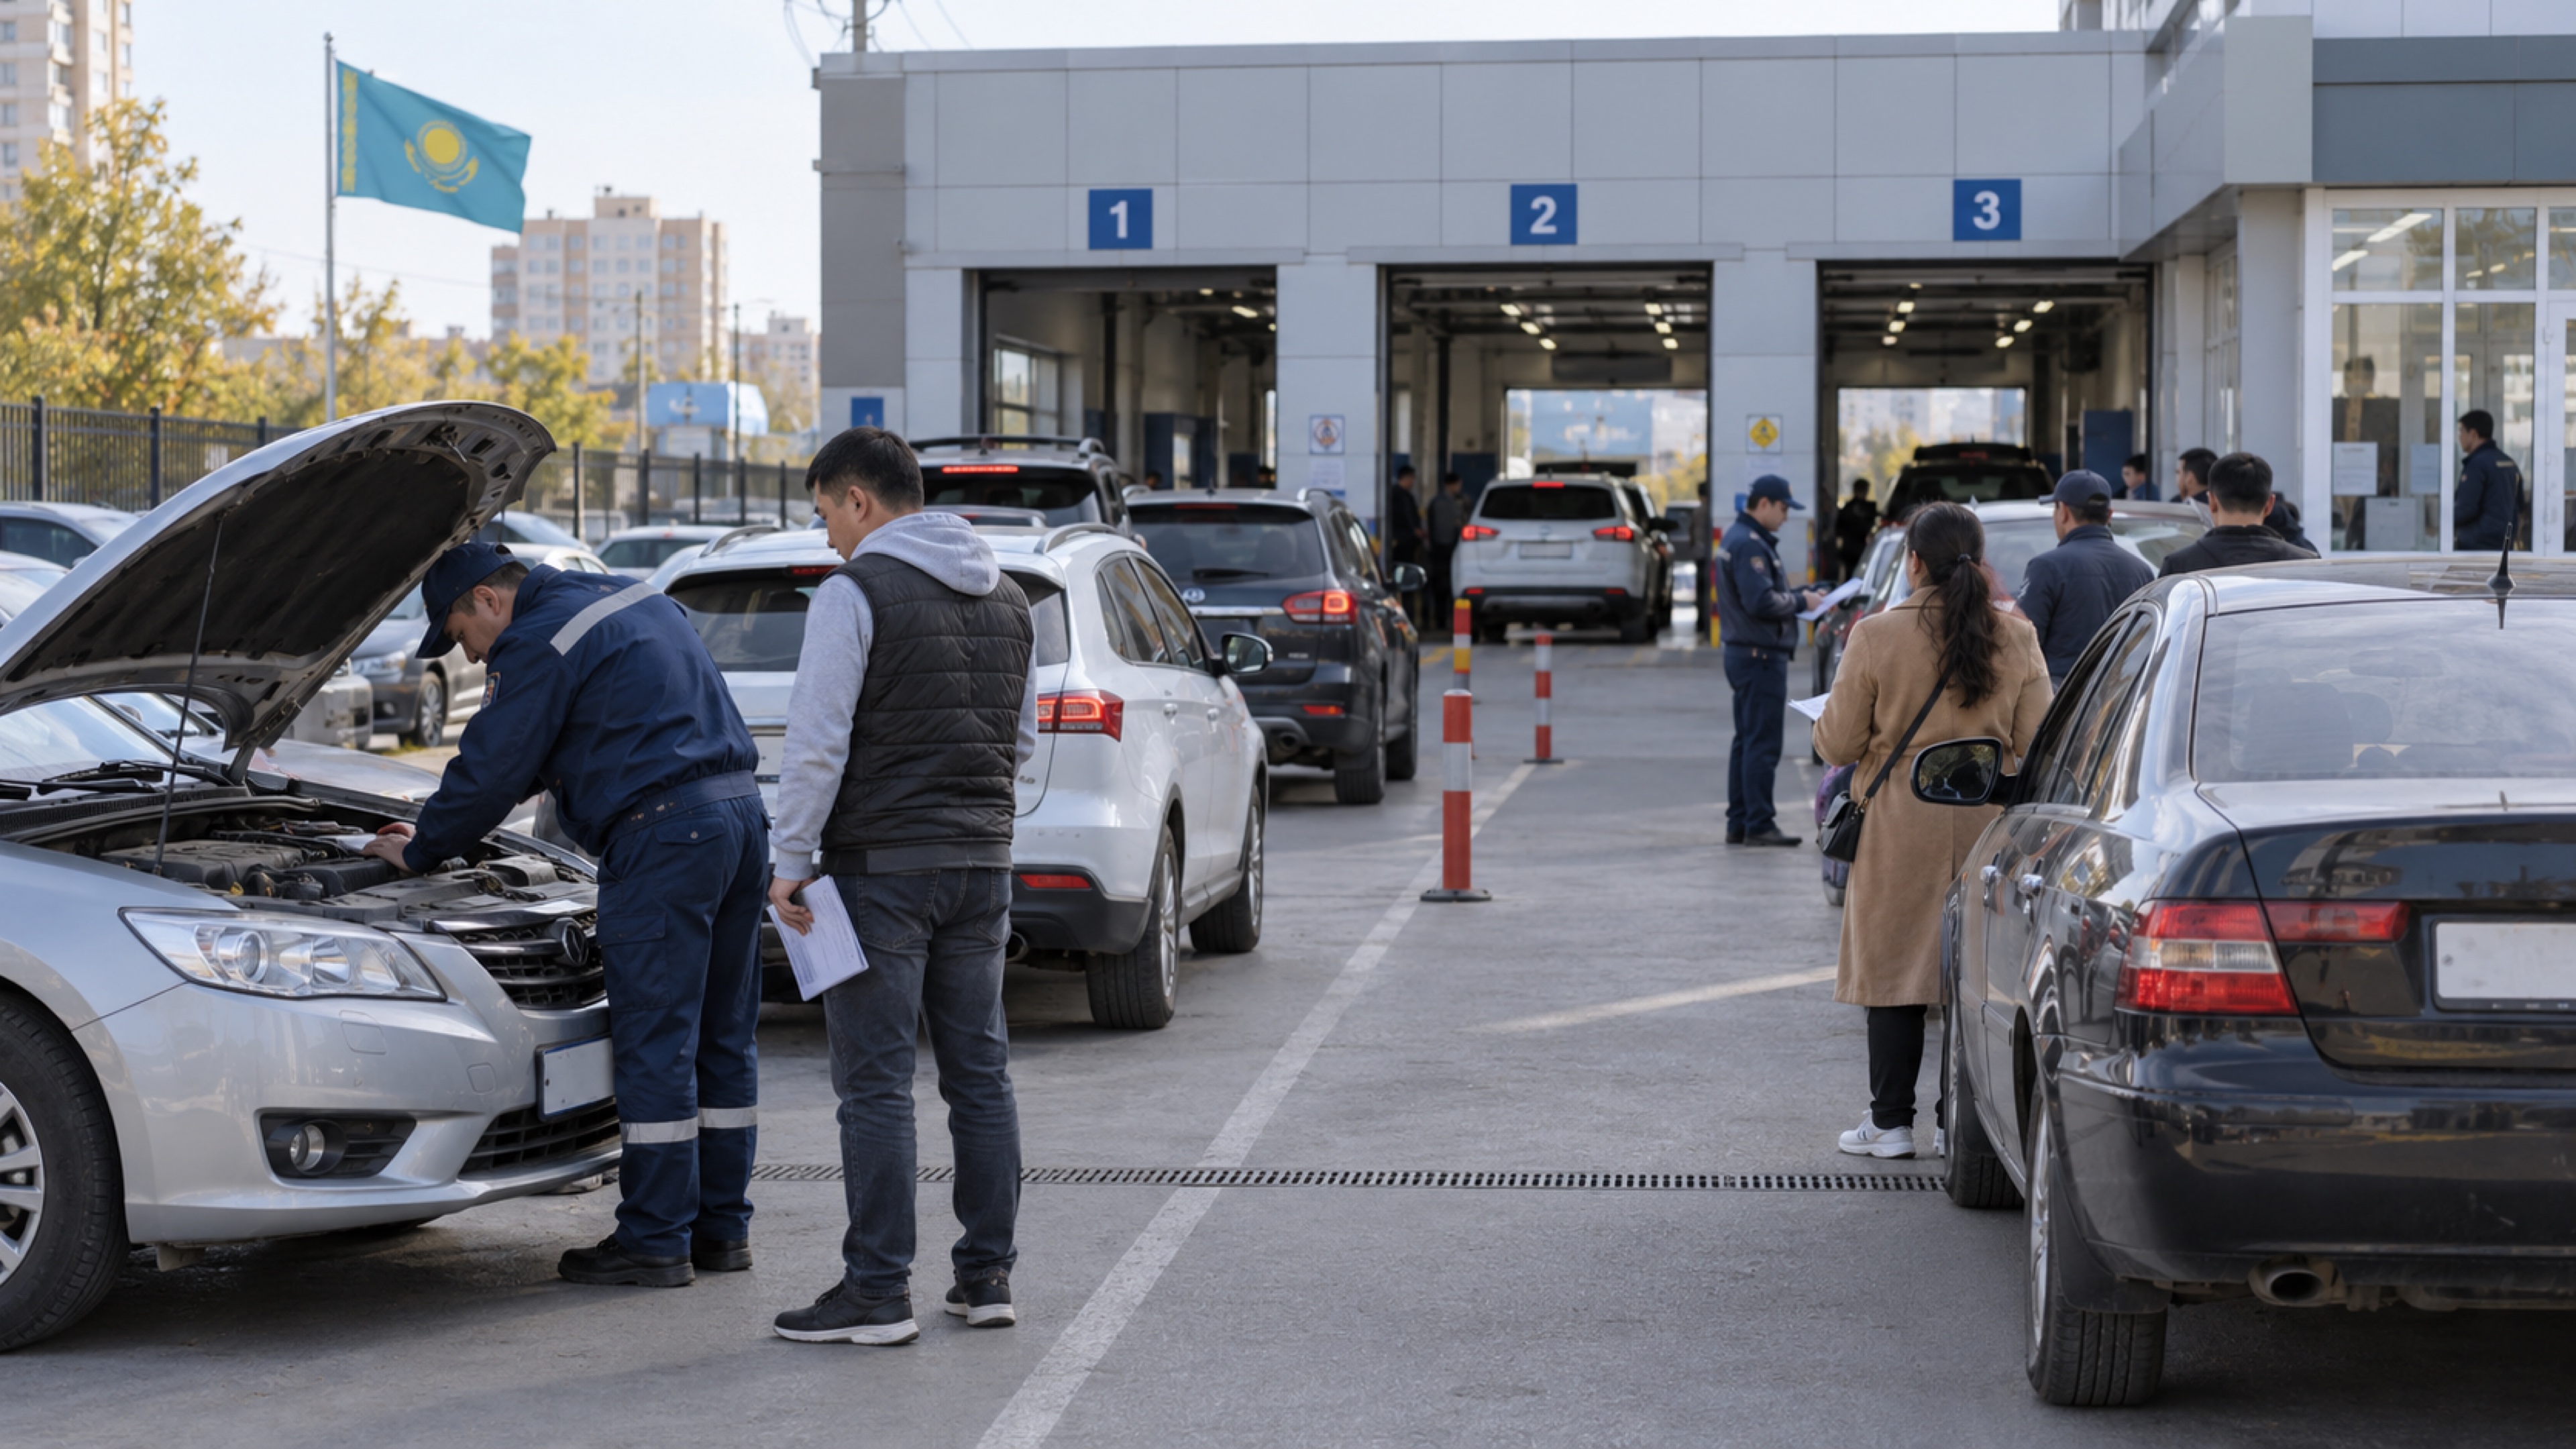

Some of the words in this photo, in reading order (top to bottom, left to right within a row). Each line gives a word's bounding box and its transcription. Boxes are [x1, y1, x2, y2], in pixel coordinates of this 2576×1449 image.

[1110, 201, 1128, 237] 1
[1529, 195, 1557, 234] 2
[1973, 191, 2000, 230] 3
